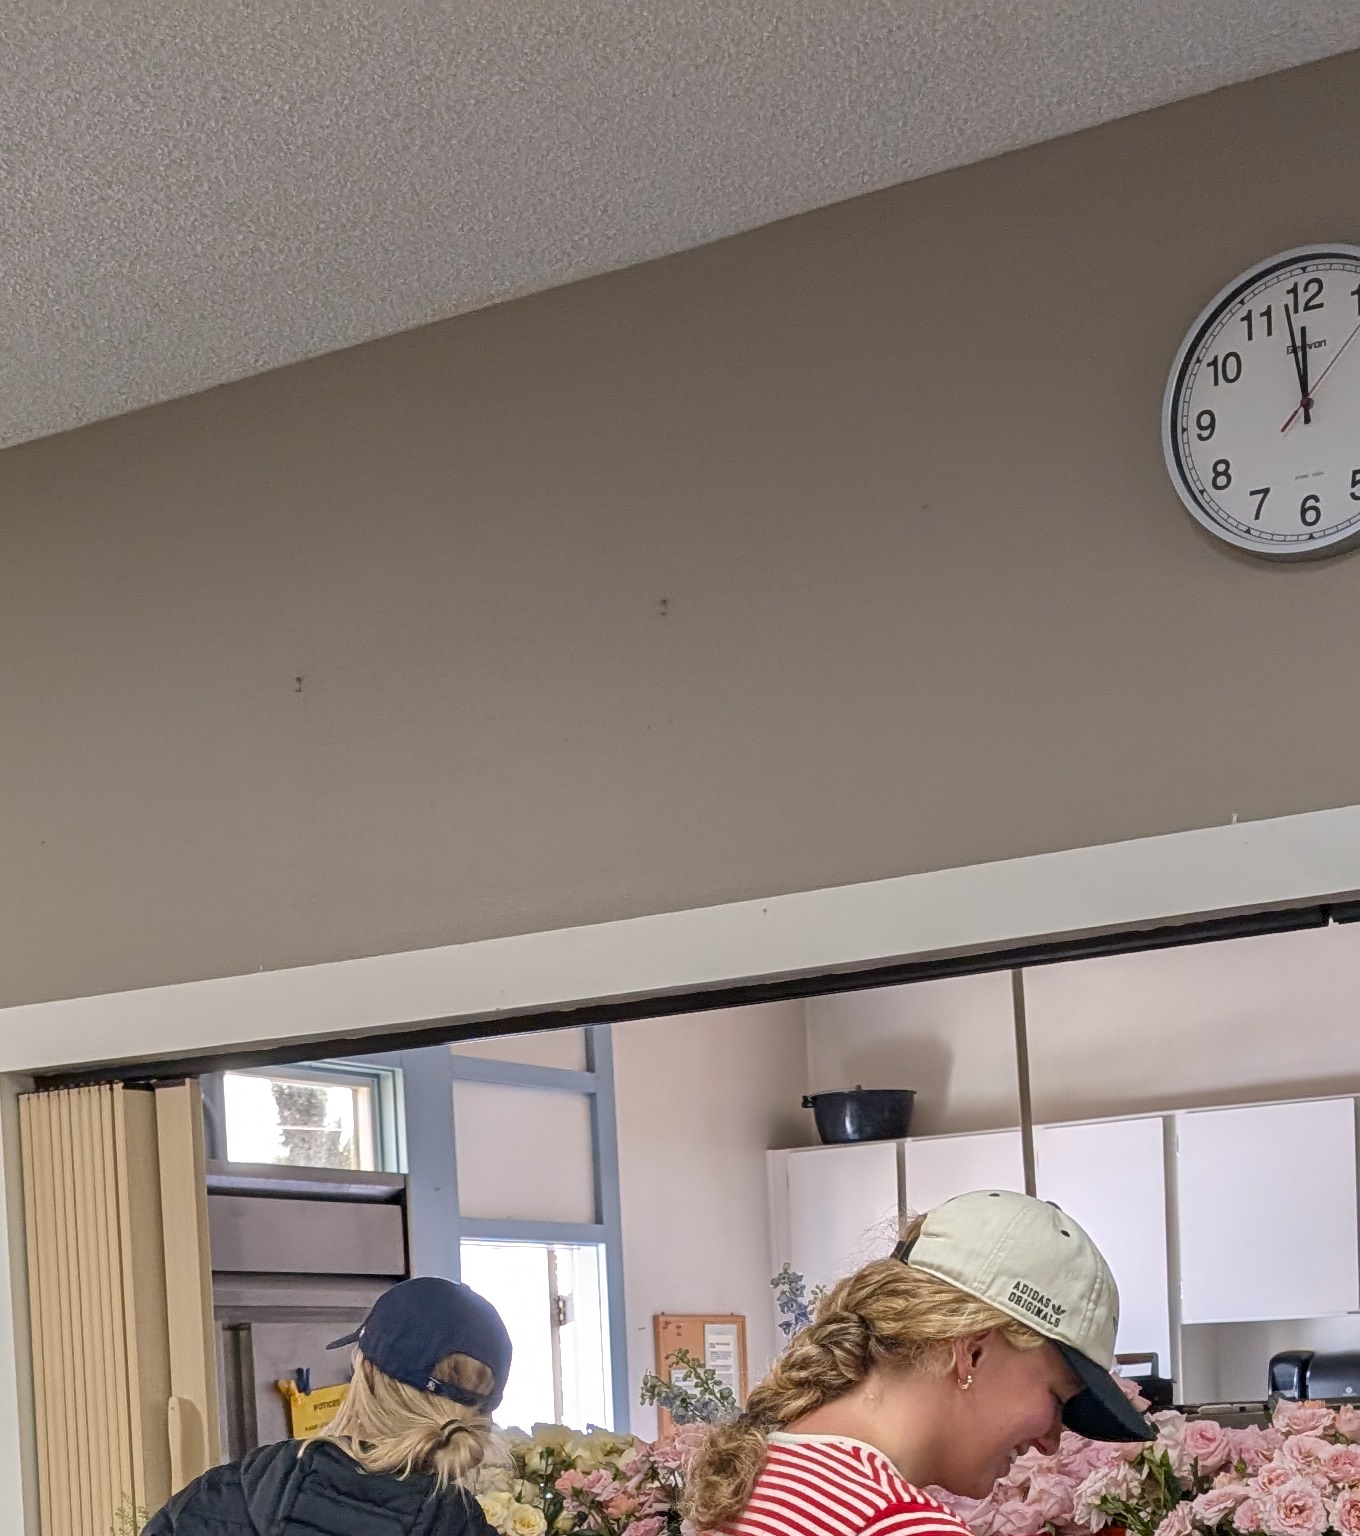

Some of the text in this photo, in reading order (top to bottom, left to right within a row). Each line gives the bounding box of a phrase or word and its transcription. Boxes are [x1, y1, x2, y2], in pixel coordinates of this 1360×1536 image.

[1286, 277, 1325, 314] 12
[1240, 305, 1274, 341] 11
[1207, 351, 1242, 386] 10
[1196, 410, 1216, 442] 9
[1211, 459, 1232, 491] 8
[1249, 488, 1271, 521] 7
[1300, 494, 1321, 527] 6
[1007, 1291, 1061, 1329] ORIGINALS
[1013, 1280, 1052, 1309] ADIDAS
